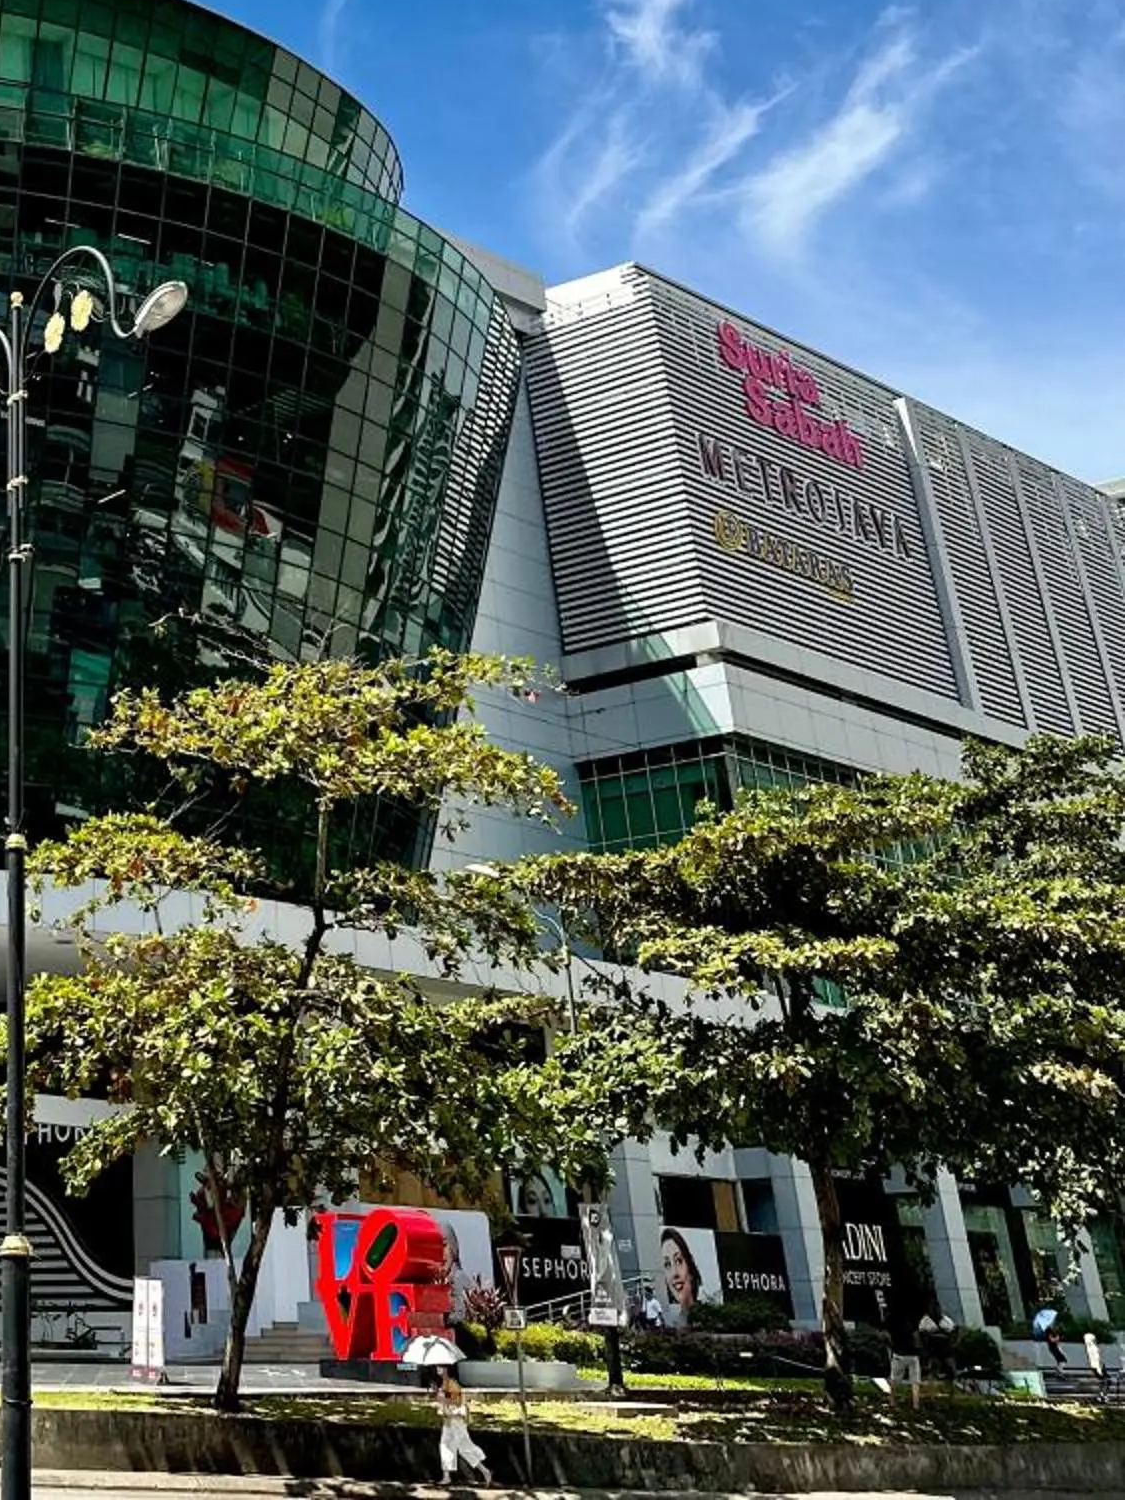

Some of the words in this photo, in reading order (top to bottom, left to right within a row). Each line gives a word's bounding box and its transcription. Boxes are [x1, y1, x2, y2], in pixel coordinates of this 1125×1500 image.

[717, 319, 821, 405] Suria
[744, 375, 865, 472] Sabah
[522, 1257, 592, 1280] SEPHOR
[726, 1271, 786, 1292] SEPHORA
